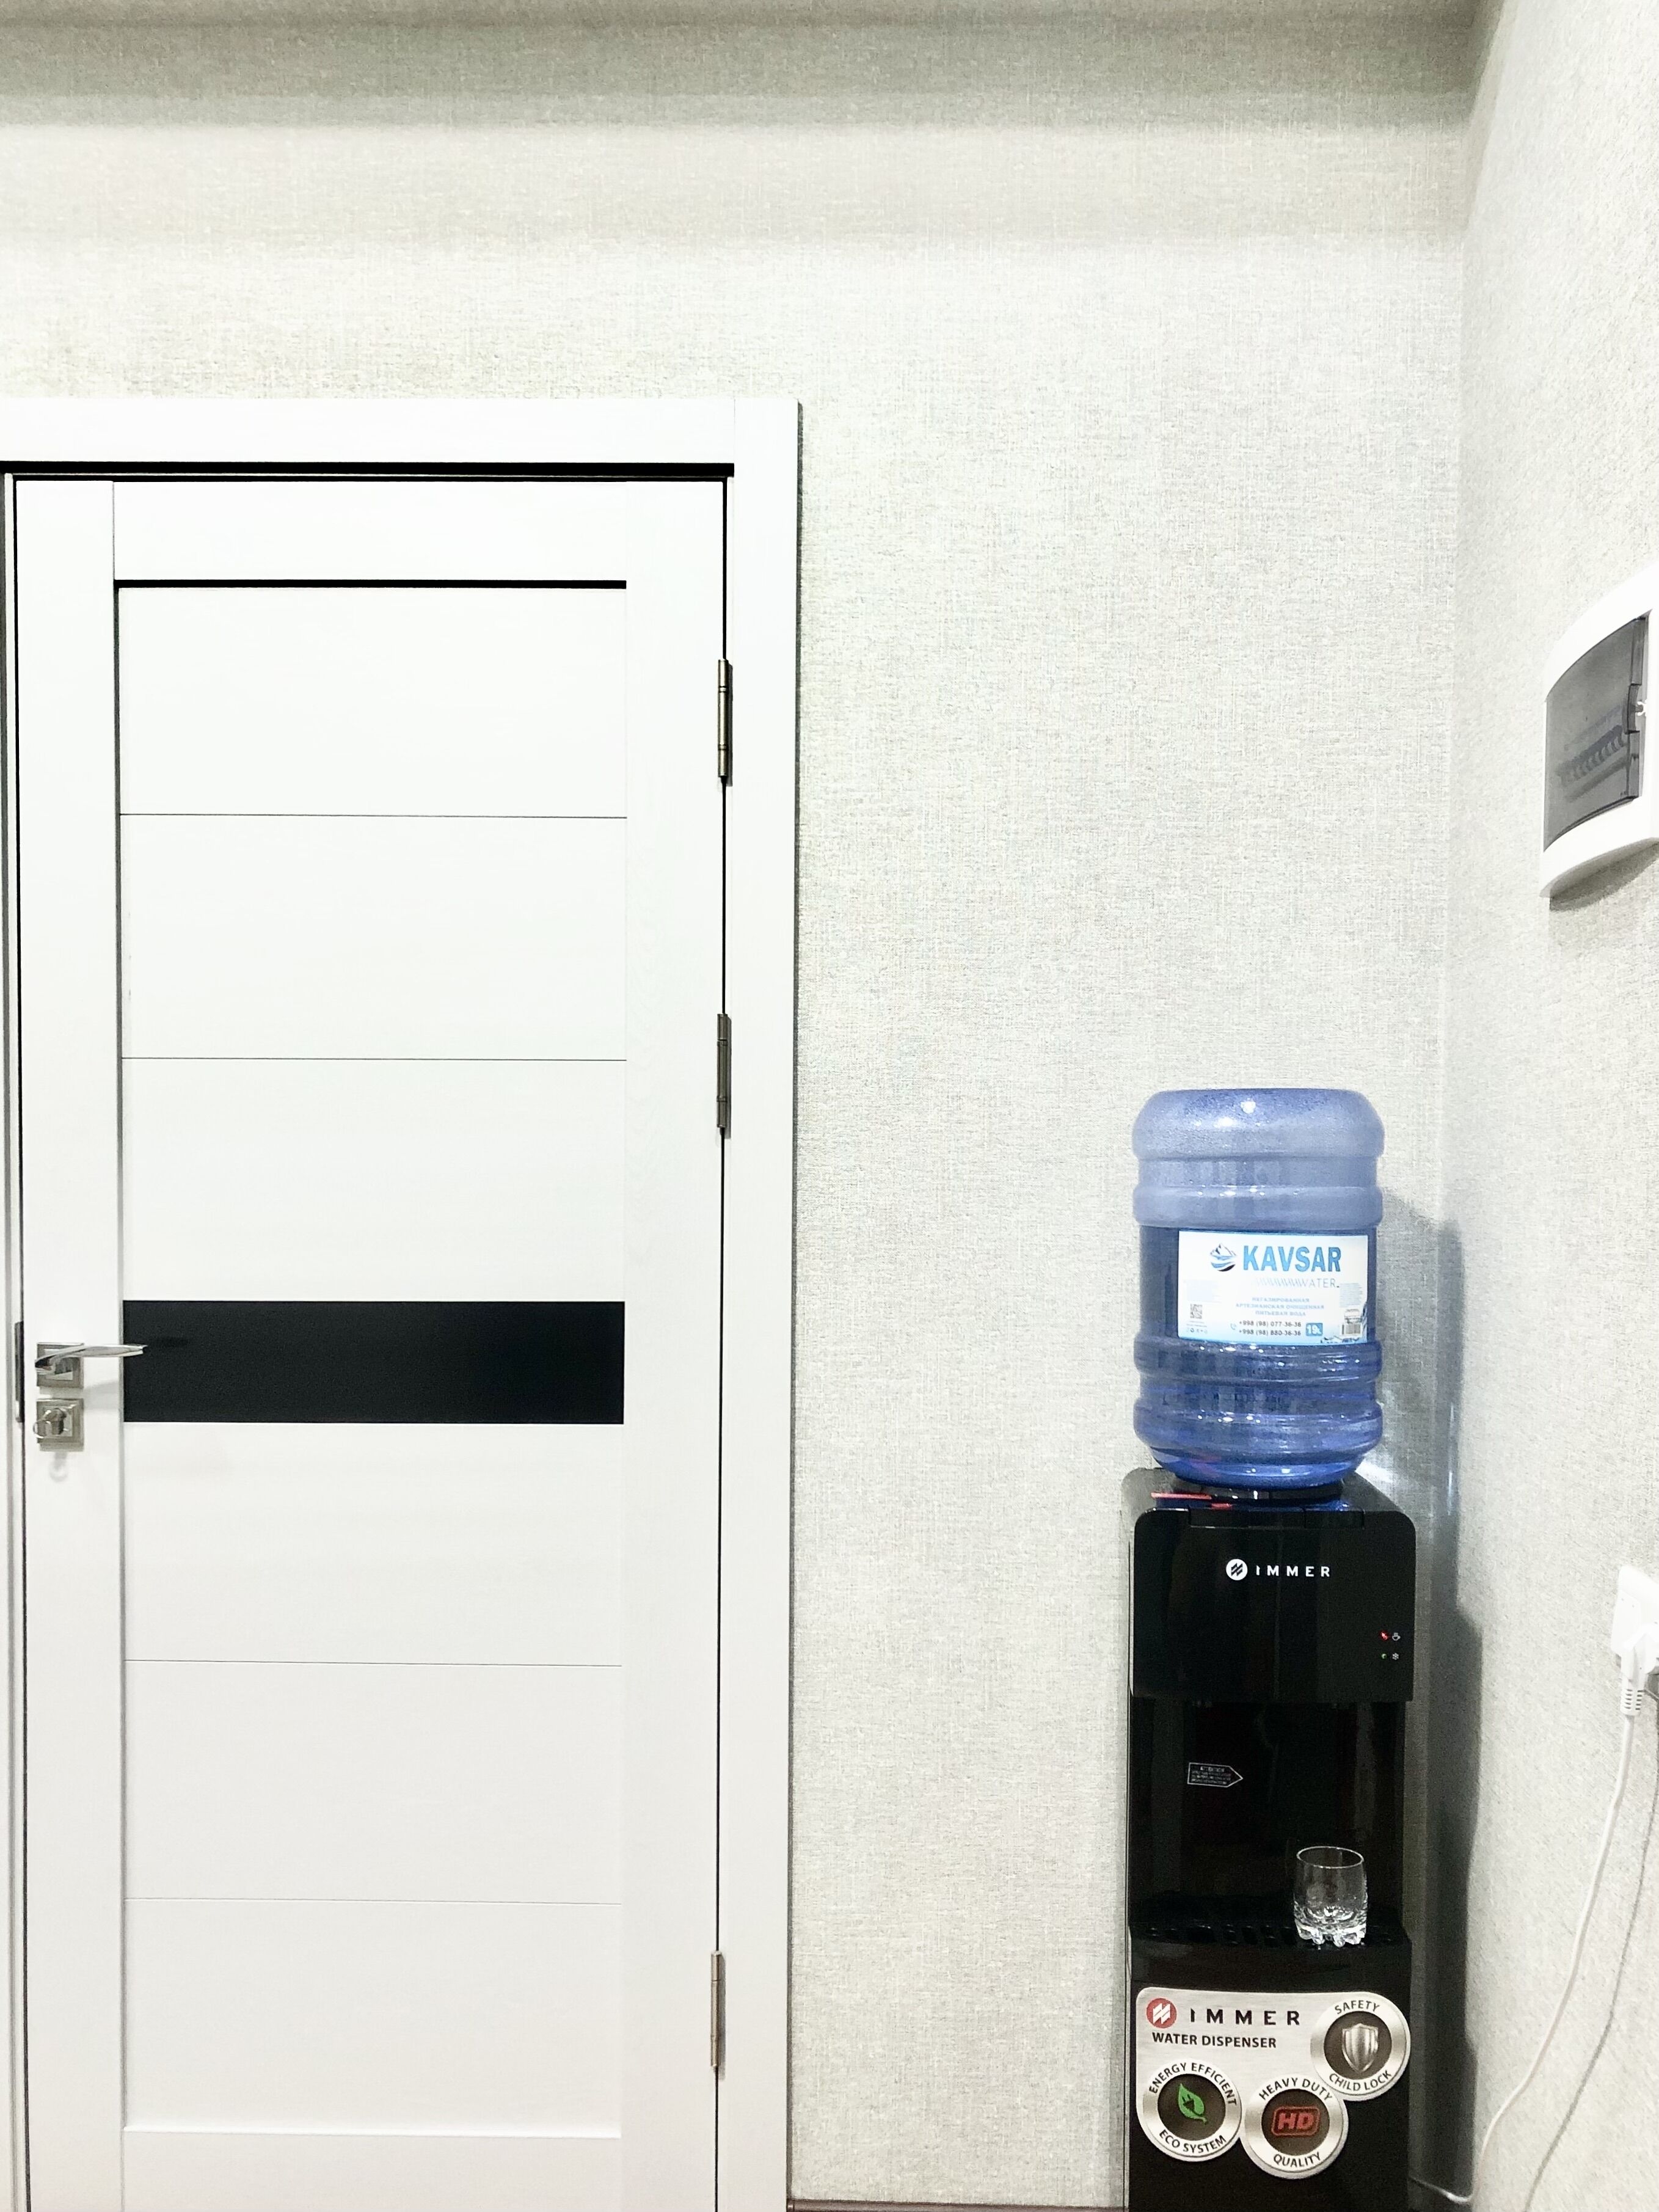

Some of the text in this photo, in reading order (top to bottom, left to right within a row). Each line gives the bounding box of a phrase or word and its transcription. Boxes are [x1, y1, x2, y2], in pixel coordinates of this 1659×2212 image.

[1243, 1245, 1341, 1272] KAVSAR
[1256, 1565, 1330, 1577] IMMER
[1334, 2000, 1380, 2015] SAFETY
[1190, 2008, 1300, 2026] IMMER
[1152, 2032, 1277, 2048] WATER DISPENSER
[1148, 2062, 1237, 2106] ENERGY EFFICIENT
[1258, 2077, 1333, 2101] HEAVY DUTY
[1329, 2070, 1392, 2091] CHILD LOCK
[1277, 2112, 1314, 2130] HD
[1159, 2129, 1227, 2153] ECO SYSTEM
[1273, 2151, 1321, 2167] QUALITY
